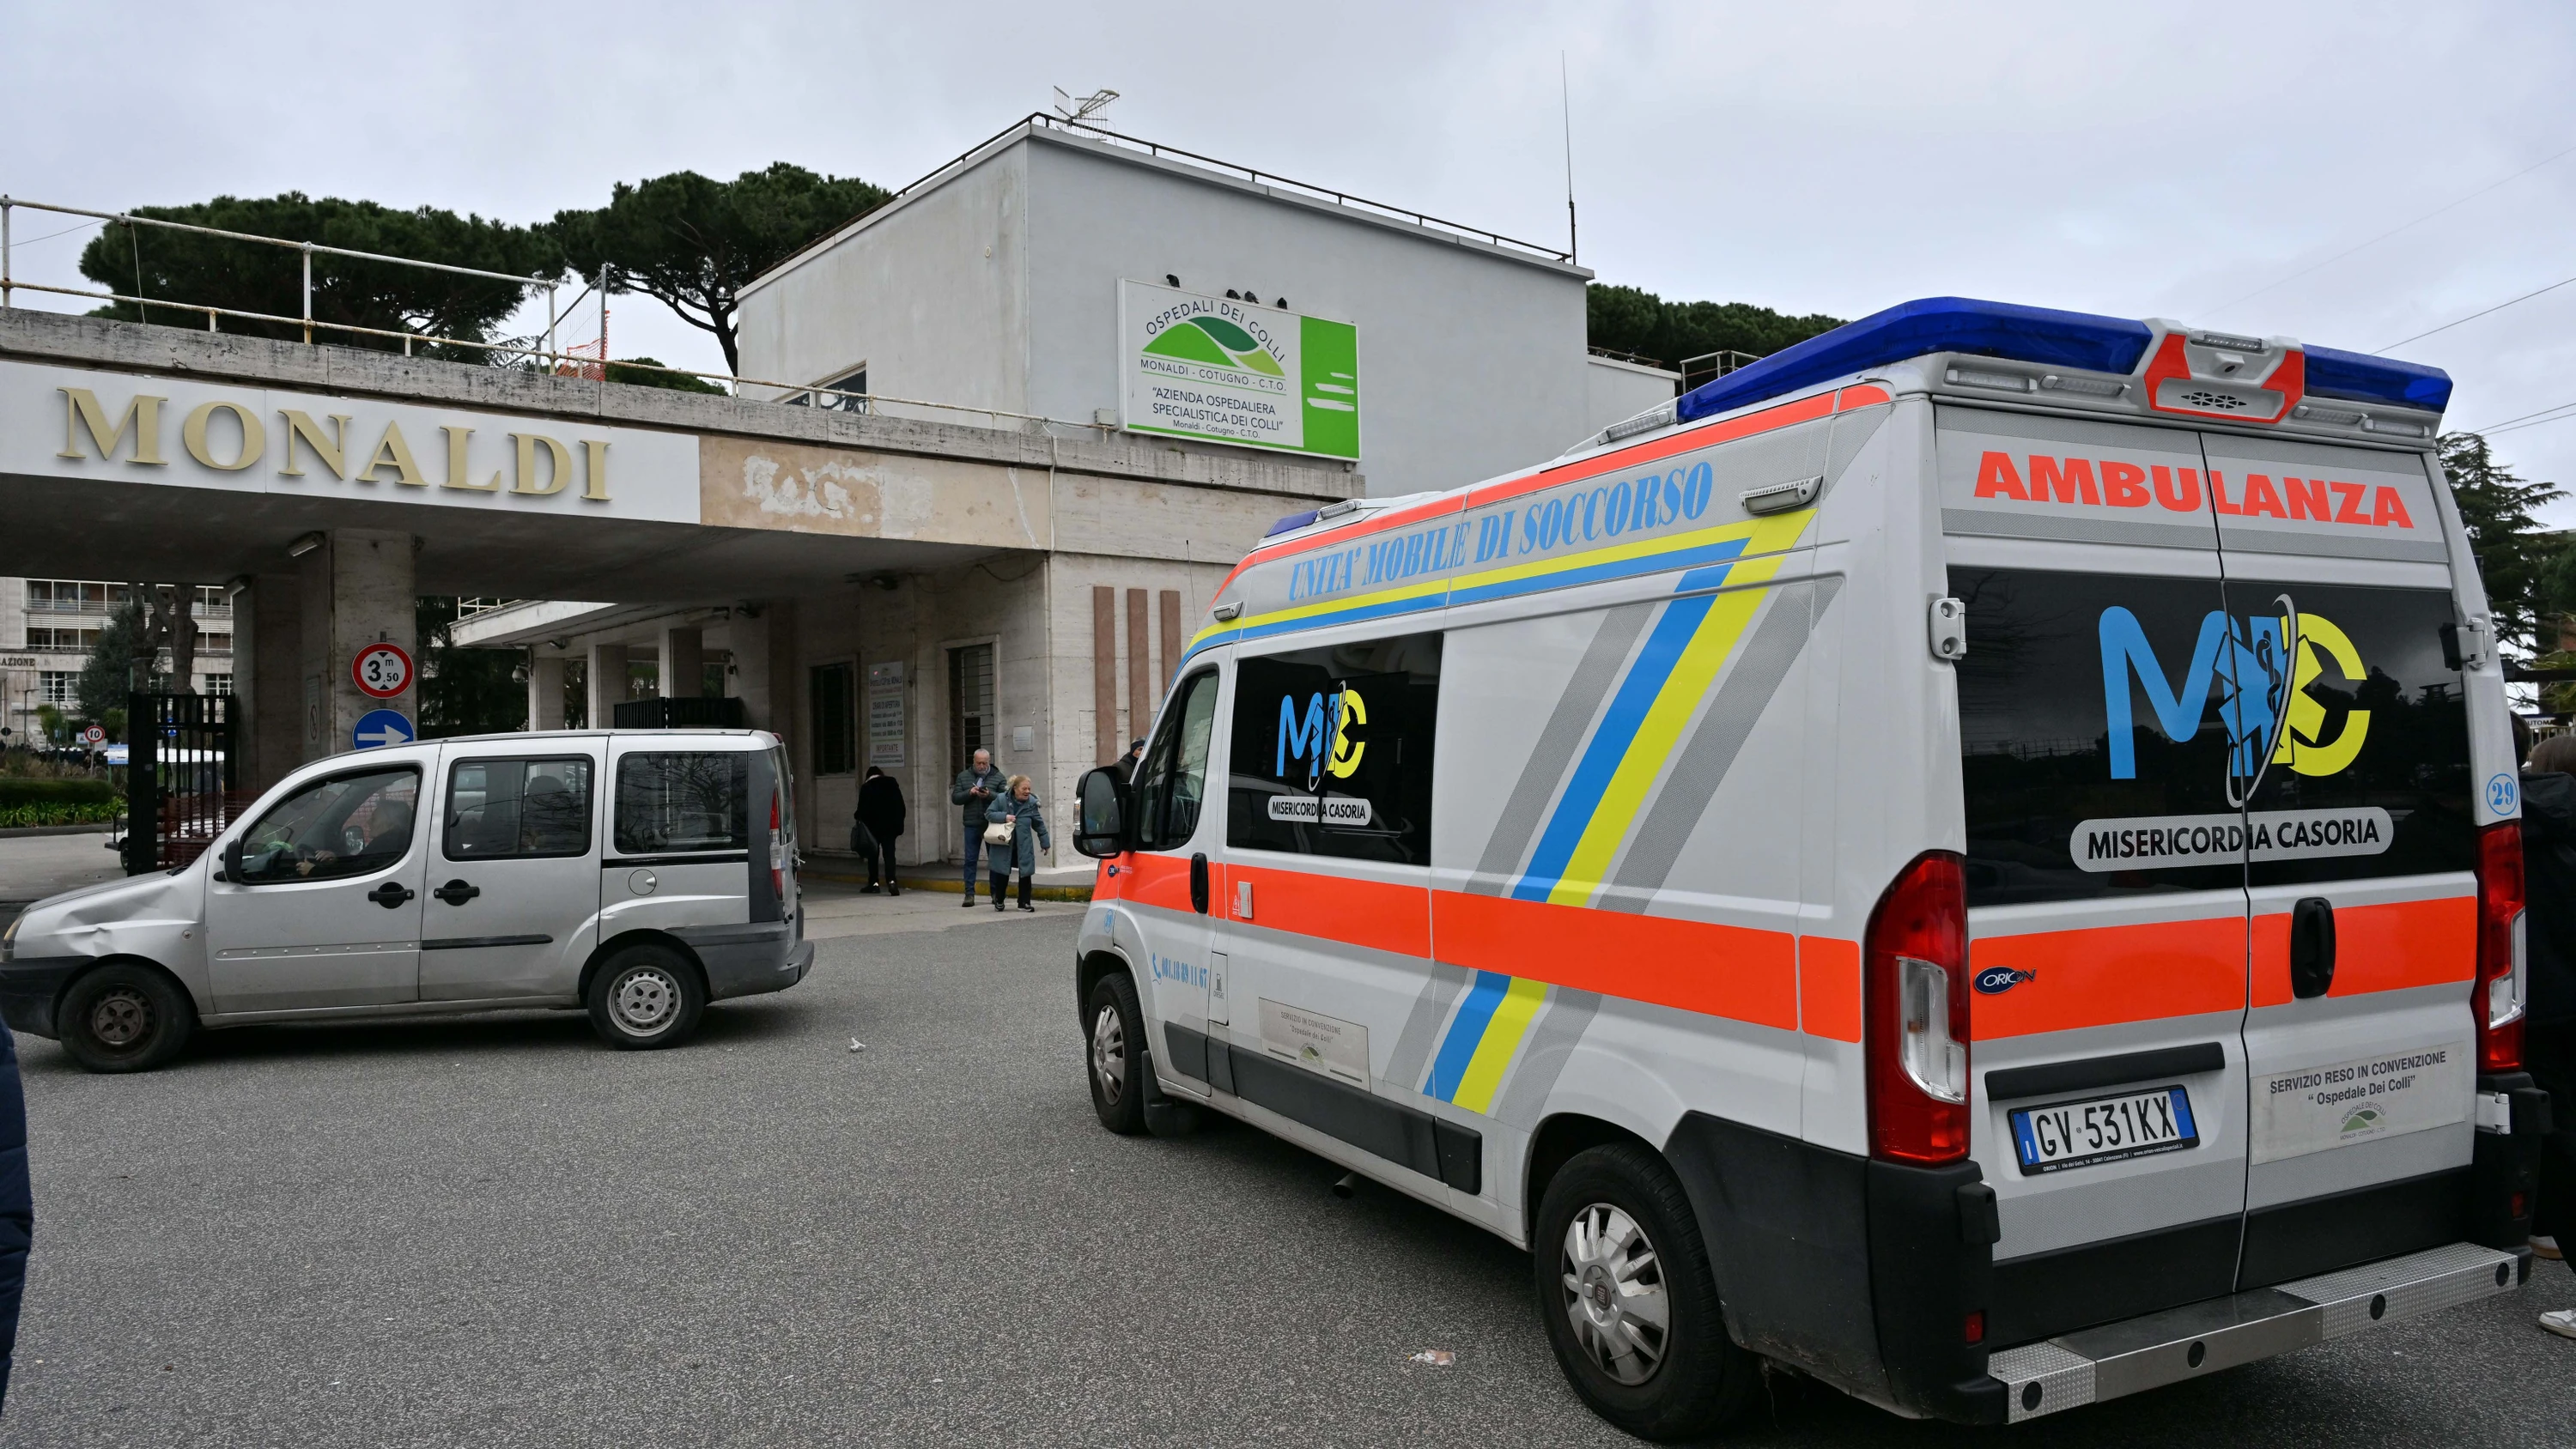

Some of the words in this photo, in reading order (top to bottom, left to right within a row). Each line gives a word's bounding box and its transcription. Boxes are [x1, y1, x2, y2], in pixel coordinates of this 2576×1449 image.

[1146, 300, 1213, 335] OSPEDALI
[1220, 303, 1244, 324] DEI
[1249, 321, 1285, 362] COLLI
[1140, 359, 1188, 375] MONALDI
[1199, 369, 1249, 385] COTUGNO
[1259, 379, 1286, 391] C.T.O.
[1152, 403, 1229, 423] SPECIALISTICA
[1231, 415, 1248, 426] DEI
[1206, 395, 1276, 415] OSPEDALIERA
[1173, 419, 1200, 430] Monaldi
[1206, 424, 1235, 435] Cotugno
[1241, 429, 1261, 439] C.T.O.
[56, 386, 614, 500] MONALDI
[1974, 451, 2415, 529] AMBULANZA
[1362, 521, 1469, 586] MOBILE
[1474, 510, 1516, 563] DI
[1518, 461, 1713, 555] SOCCORSO
[0, 658, 35, 667] AZIONE
[89, 730, 100, 738] 10
[2492, 781, 2514, 806] 29
[1272, 801, 1327, 817] MISERICORDIA
[1328, 803, 1366, 819] CASORIA
[2087, 823, 2272, 859] MISERICORDIA
[2277, 818, 2380, 847] CASORIA
[1984, 967, 2037, 987] ORION
[1280, 1011, 1302, 1023] SERVIZIO
[1302, 1016, 1308, 1025] IN
[1308, 1019, 1341, 1035] CONVENZIONE
[2269, 1073, 2322, 1094] SERVIZIO
[2324, 1068, 2354, 1084] RESO
[2358, 1065, 2369, 1078] IN
[2372, 1051, 2446, 1076] CONVENZIONE
[2317, 1085, 2366, 1106] Ospedale
[2369, 1081, 2385, 1095] Dei
[2036, 1111, 2073, 1156] GV
[2085, 1095, 2176, 1149] 531KX
[2341, 1102, 2365, 1125] OSPEDALE
